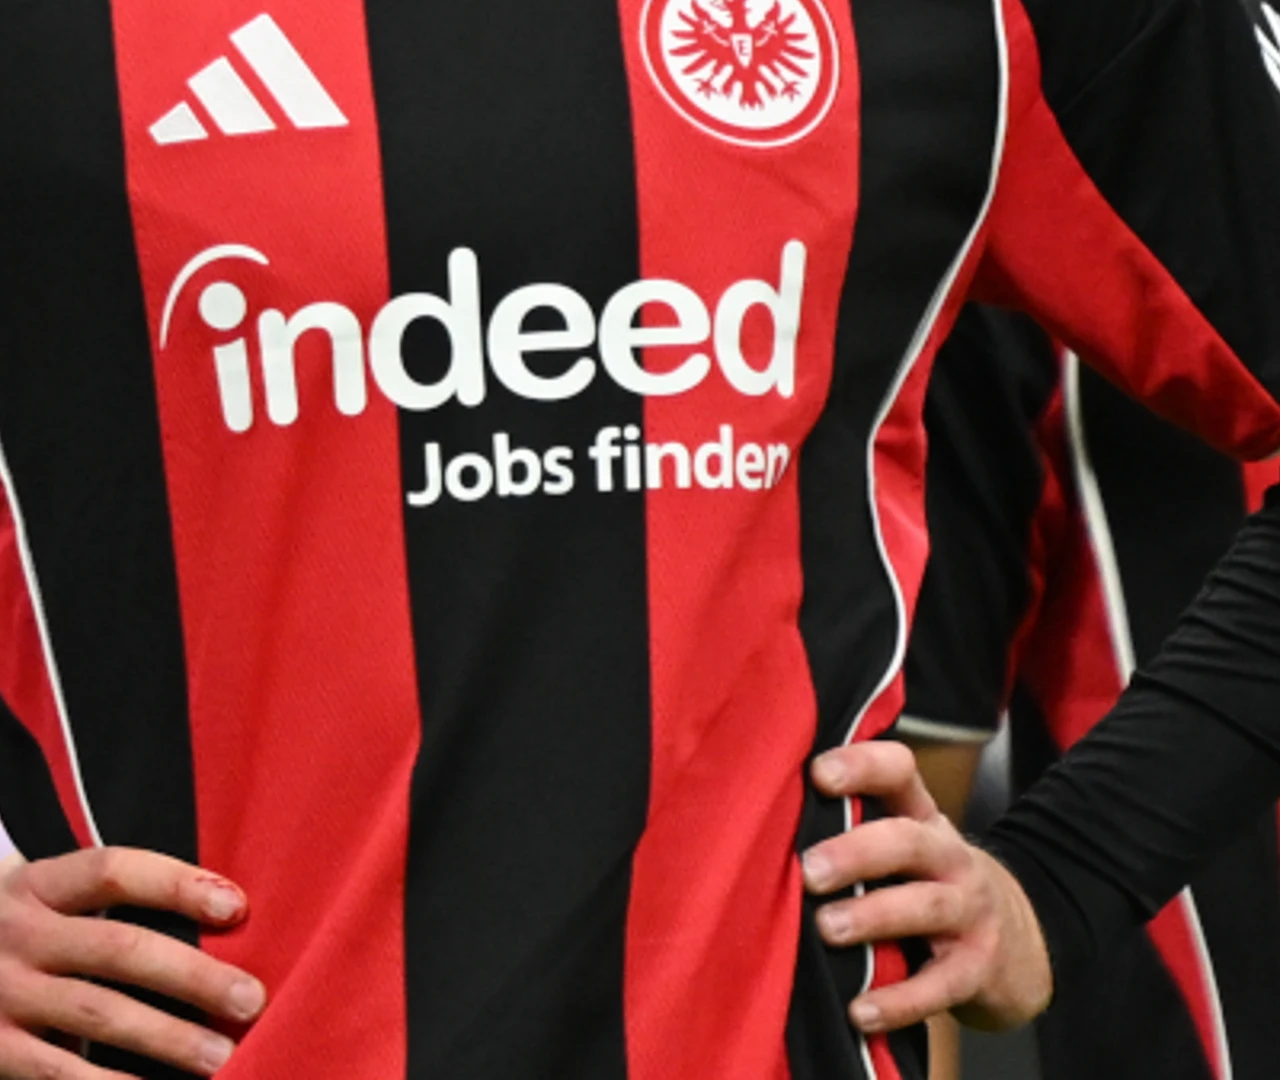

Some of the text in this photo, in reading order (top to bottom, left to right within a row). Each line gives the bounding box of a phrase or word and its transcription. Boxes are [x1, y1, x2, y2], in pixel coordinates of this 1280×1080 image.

[198, 239, 806, 433] indeed
[407, 423, 791, 507] Jobs finden
